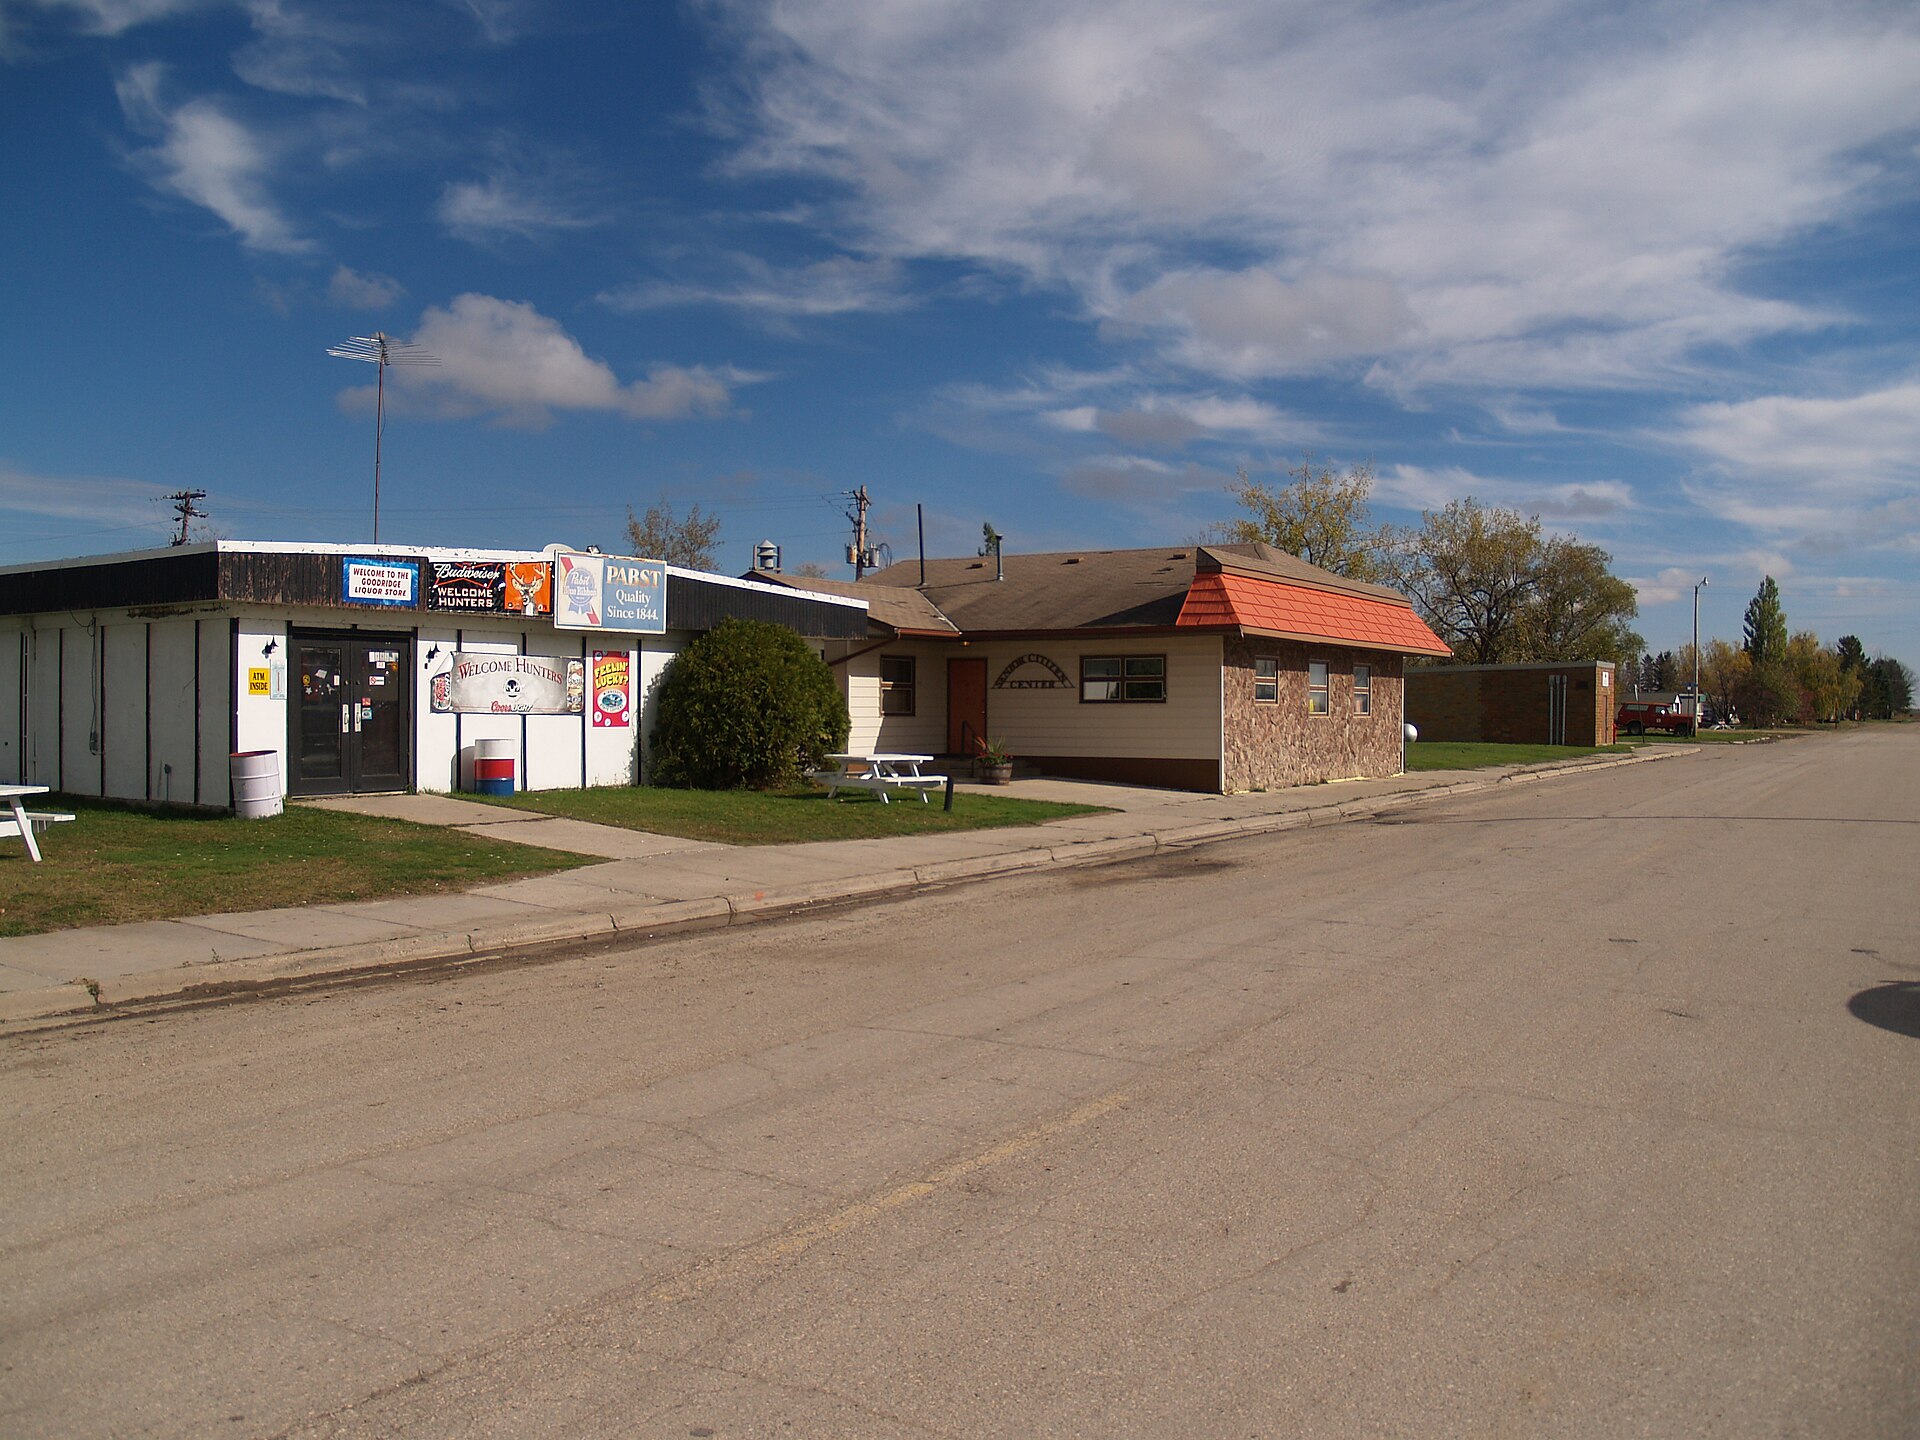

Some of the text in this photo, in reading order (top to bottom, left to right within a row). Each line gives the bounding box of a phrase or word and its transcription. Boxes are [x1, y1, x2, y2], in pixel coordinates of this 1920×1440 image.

[353, 567, 409, 580] WELCOME TO THE
[433, 563, 500, 579] Budweiser
[606, 565, 662, 588] PABST
[361, 577, 402, 588] GOODRIDGE
[354, 586, 407, 597] LIQUOR STORE
[437, 587, 494, 598] WELCOME
[438, 597, 494, 608] HUNTERS
[615, 588, 651, 608] Quality
[607, 605, 659, 621] Since 1844.
[594, 661, 629, 679] FEELIN'
[253, 672, 265, 681] ATM
[595, 674, 629, 690] LUCKY?
[249, 682, 268, 691] INSIDE
[1009, 680, 1056, 689] CENTER
